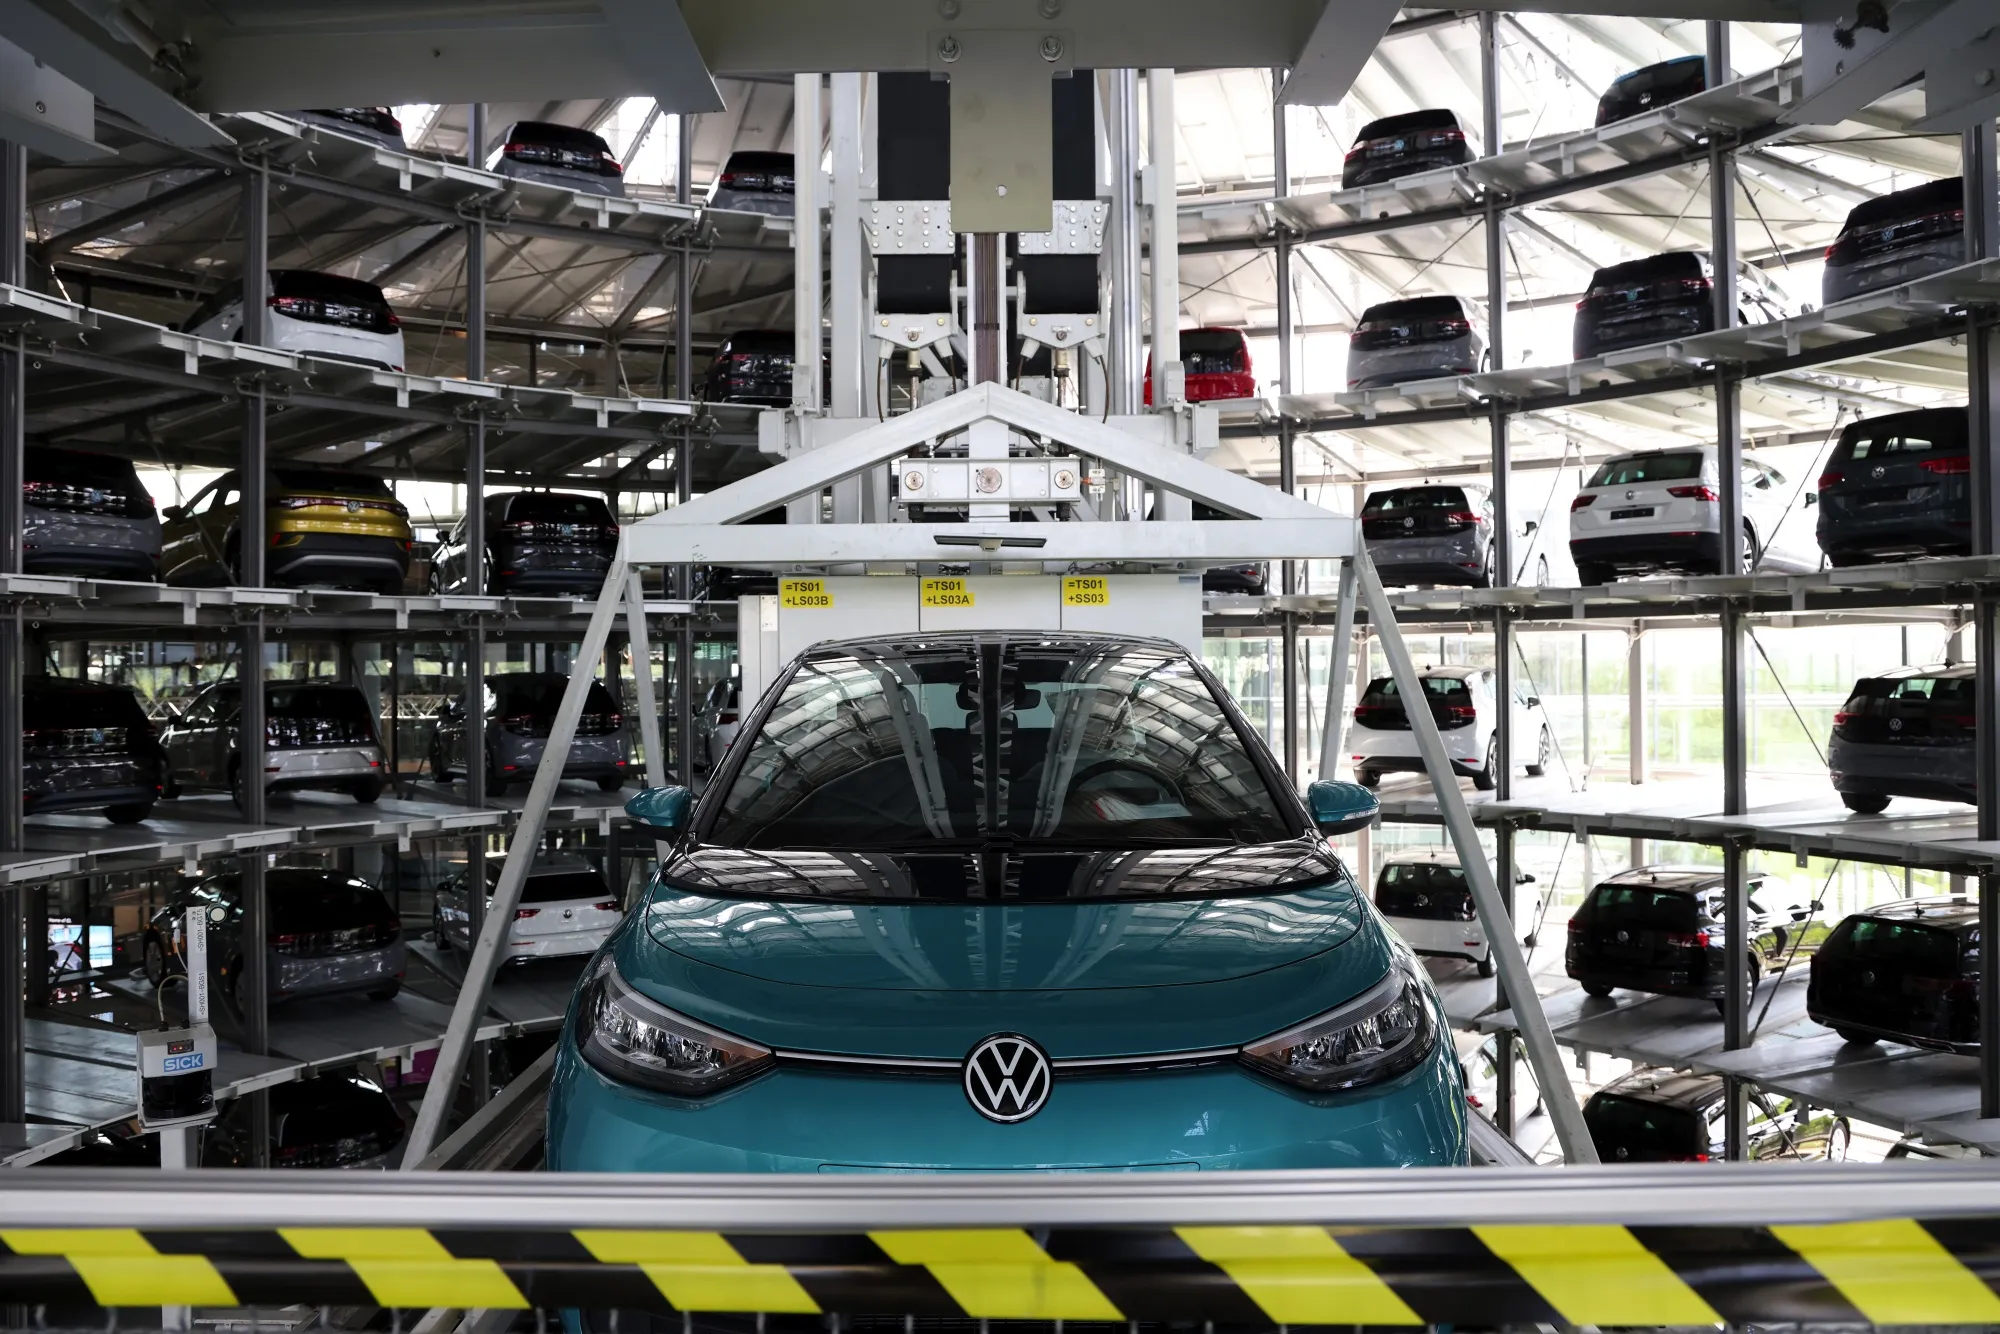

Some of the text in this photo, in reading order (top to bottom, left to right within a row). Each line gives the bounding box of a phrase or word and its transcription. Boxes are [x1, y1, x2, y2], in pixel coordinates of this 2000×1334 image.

[785, 582, 820, 592] =TS01
[926, 581, 961, 591] =TS01
[1068, 580, 1103, 589] =TS01
[785, 595, 829, 606] +LS03B
[926, 595, 970, 605] +LS03A
[1068, 593, 1104, 603] +SS03
[165, 1054, 202, 1071] SICK
[965, 1037, 1050, 1121] VW
